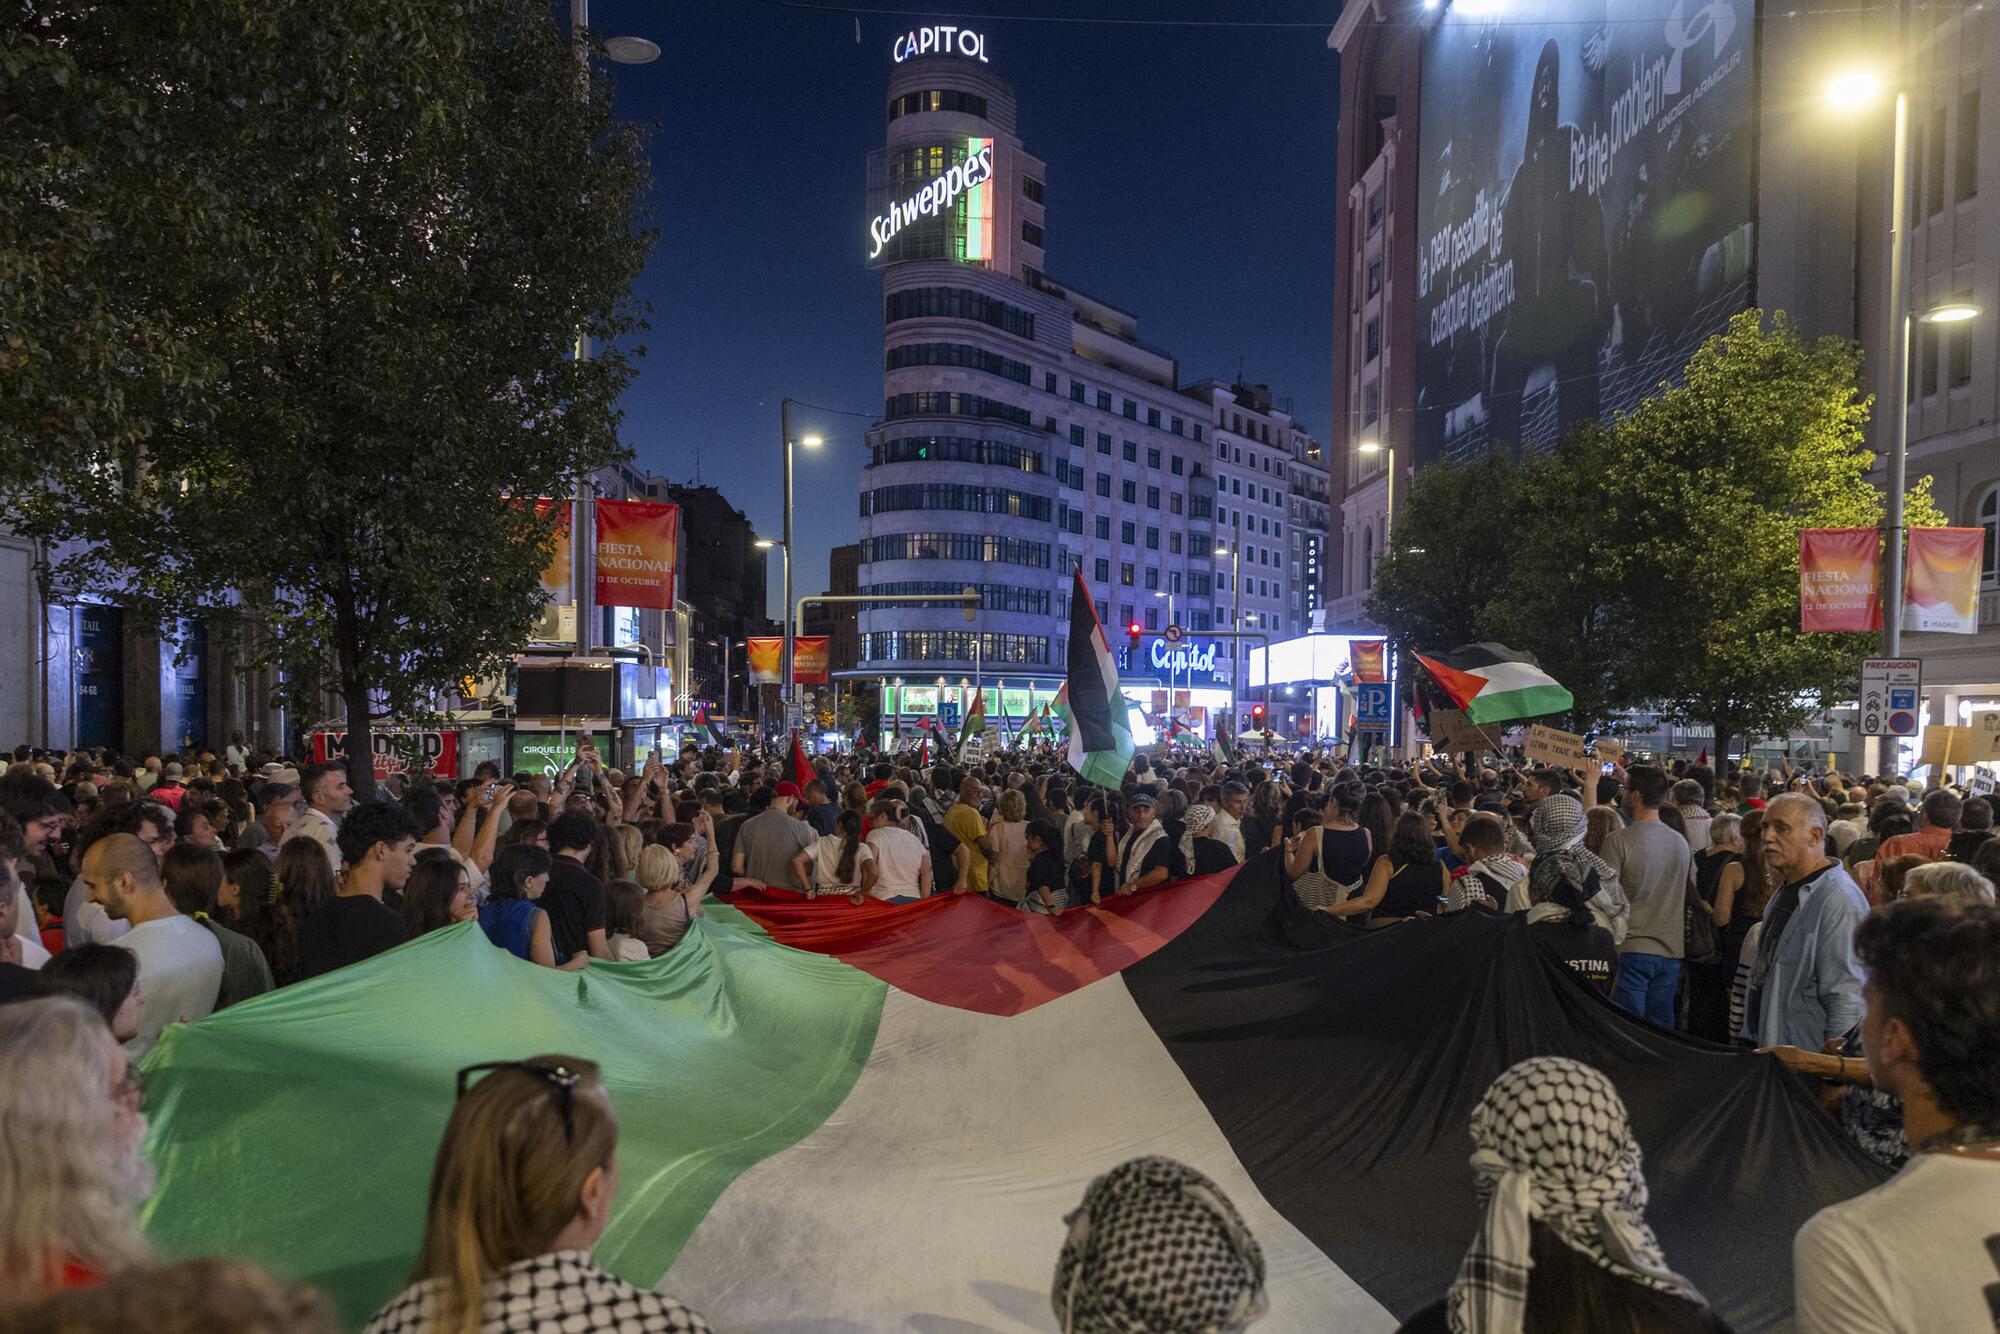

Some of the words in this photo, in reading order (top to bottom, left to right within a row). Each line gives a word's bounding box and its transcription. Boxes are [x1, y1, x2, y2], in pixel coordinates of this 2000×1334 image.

[893, 25, 989, 63] CAPITOL
[1657, 94, 1692, 135] UNDER
[1692, 49, 1742, 105] ARMOUR
[1569, 126, 1586, 193] be
[1587, 121, 1609, 197] the
[1609, 52, 1665, 177] problem
[869, 146, 992, 260] Schweppes
[1419, 245, 1428, 299] la
[1430, 223, 1452, 292] peor
[1450, 188, 1489, 289] pesadilla
[1490, 196, 1503, 262] de
[1430, 272, 1471, 349] cualquier
[598, 542, 643, 556] FIESTA
[598, 558, 672, 573] NACIONAL
[1308, 540, 1316, 574] ROOM
[607, 576, 619, 584] DE
[620, 577, 661, 587] OCTUBRE
[1804, 571, 1850, 583] FIESTA
[1804, 584, 1876, 596] NACIONAL
[1151, 638, 1216, 676] Capitol
[1865, 661, 1918, 670] PRECAUCIÓN
[522, 745, 555, 756] CIRQUE
